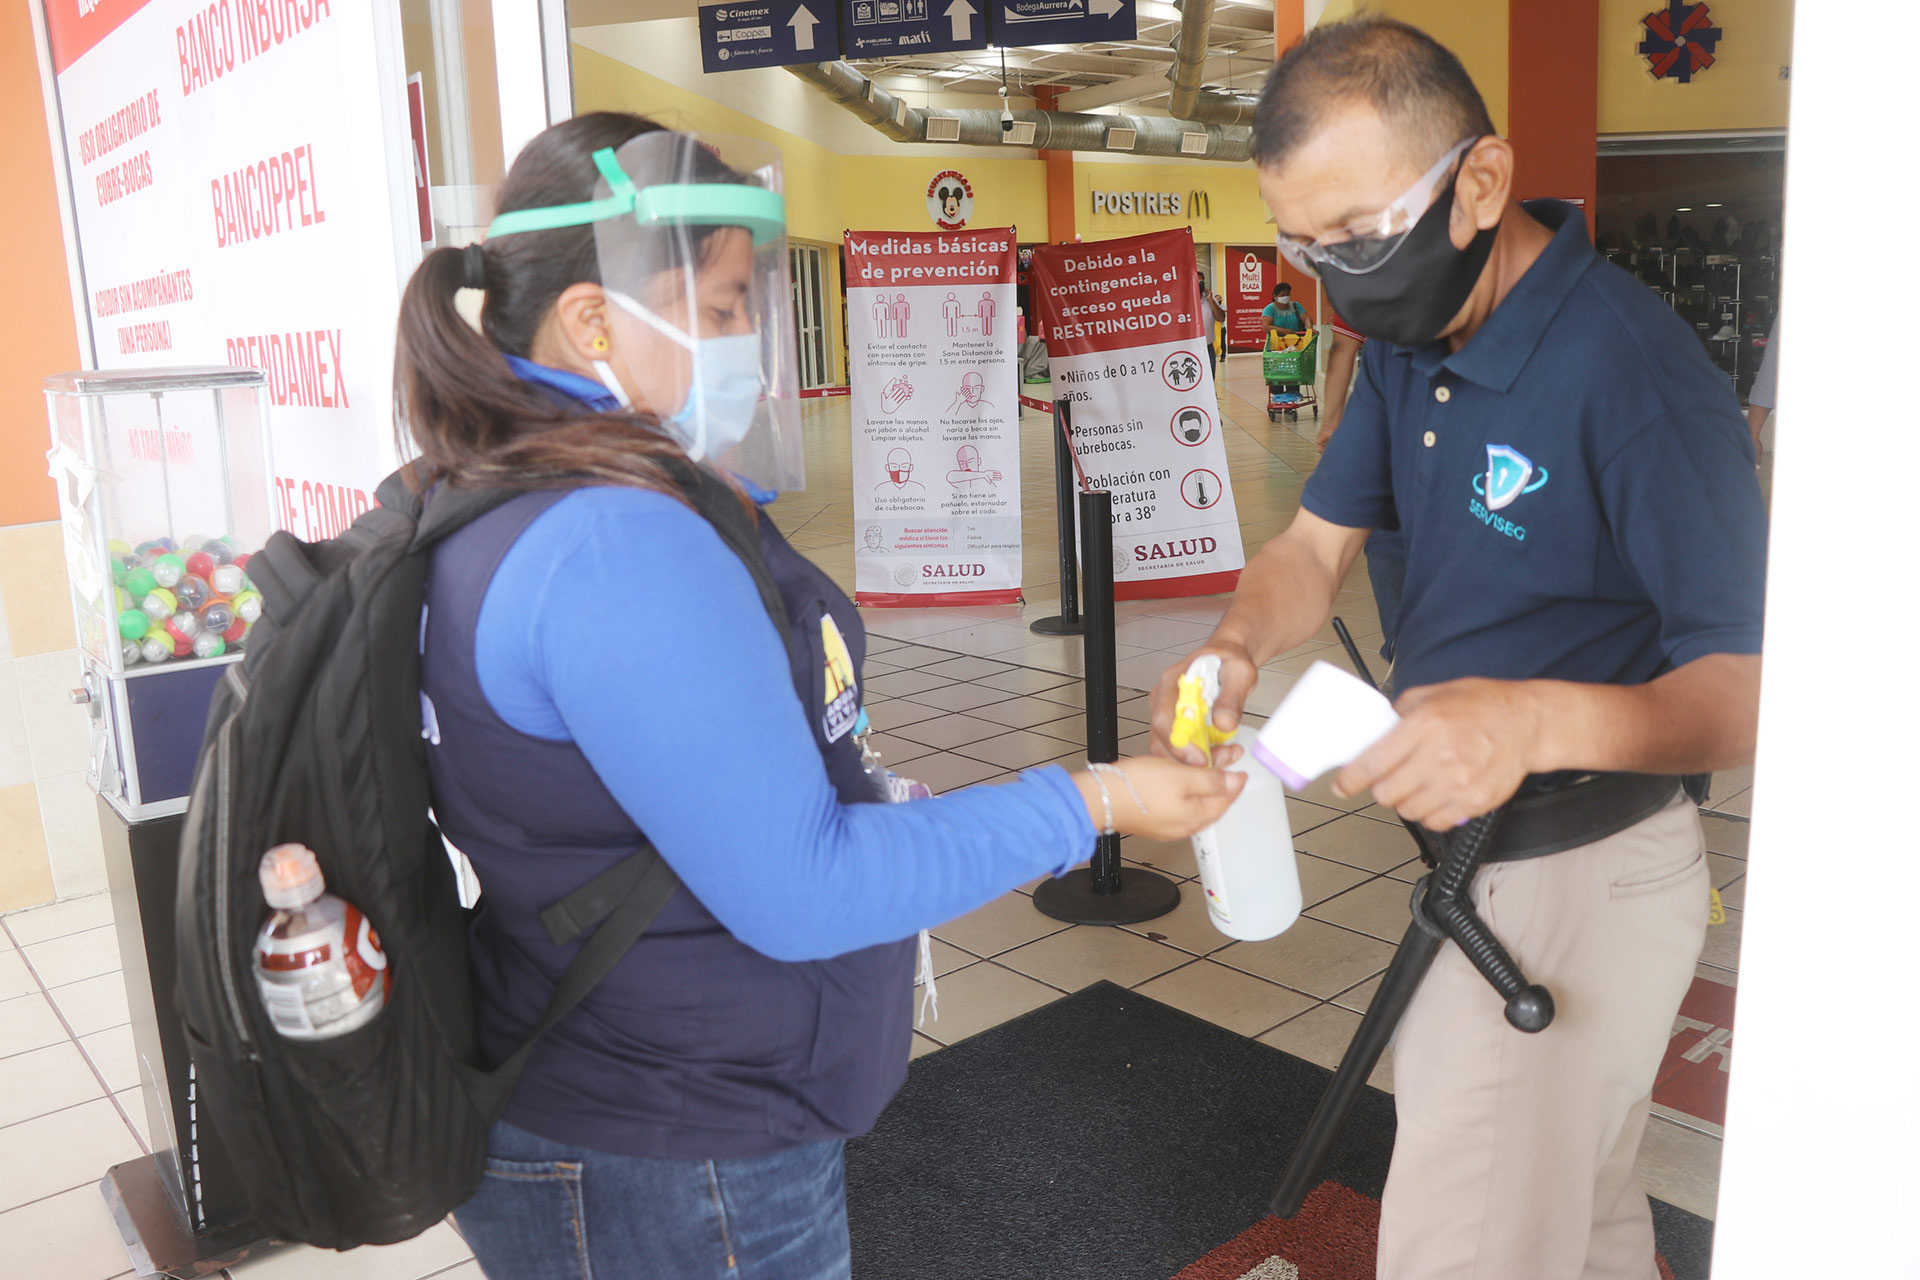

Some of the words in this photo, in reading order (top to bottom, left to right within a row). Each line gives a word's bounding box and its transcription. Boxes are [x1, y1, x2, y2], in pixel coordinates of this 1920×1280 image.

[729, 8, 770, 18] Cinemex
[736, 29, 768, 40] Coppel
[176, 0, 235, 97] BANCO
[80, 128, 97, 166] USO
[95, 96, 148, 158] OBLIGATORIO
[147, 88, 162, 128] DE
[96, 150, 153, 208] CUBRE-BOCAS
[211, 143, 326, 249] BANCOPPEL
[1092, 190, 1182, 216] POSTRES
[850, 238, 932, 256] Medidas
[938, 236, 1008, 254] básicas
[1064, 252, 1123, 273] Debido
[1128, 254, 1137, 264] a
[1141, 248, 1156, 263] la
[861, 262, 884, 279] de
[891, 260, 1000, 283] prevención
[1050, 272, 1158, 297] contingencia,
[1162, 266, 1178, 282] el
[1242, 272, 1260, 281] Multi
[94, 286, 121, 318] ACUDIR
[119, 283, 133, 314] SIN
[132, 268, 194, 311] ACOMPAÑANTES
[1062, 301, 1116, 317] acceso
[1121, 290, 1171, 313] queda
[1053, 311, 1173, 340] RESTRINGIDO
[1177, 312, 1192, 324] a:
[880, 352, 913, 360] personas
[908, 360, 928, 368] gripe.
[1067, 370, 1100, 384] Niños
[1103, 366, 1117, 379] de
[1120, 364, 1127, 376] 0
[1130, 365, 1137, 375] a
[1141, 360, 1155, 374] 12
[1062, 390, 1092, 402] años.
[878, 426, 897, 435] jabón
[1075, 422, 1124, 438] Personas
[1127, 419, 1143, 431] sin
[1073, 439, 1136, 456] ubrebocas.
[1086, 470, 1145, 490] Población
[1150, 468, 1171, 482] con
[889, 496, 926, 504] obligatorio
[1112, 490, 1156, 505] eratura
[1125, 512, 1132, 522] a
[1469, 498, 1527, 541] SERVISEG
[1134, 536, 1217, 562] SALUD
[922, 564, 986, 578] SALUD
[1138, 563, 1174, 571] SECRETARÍA
